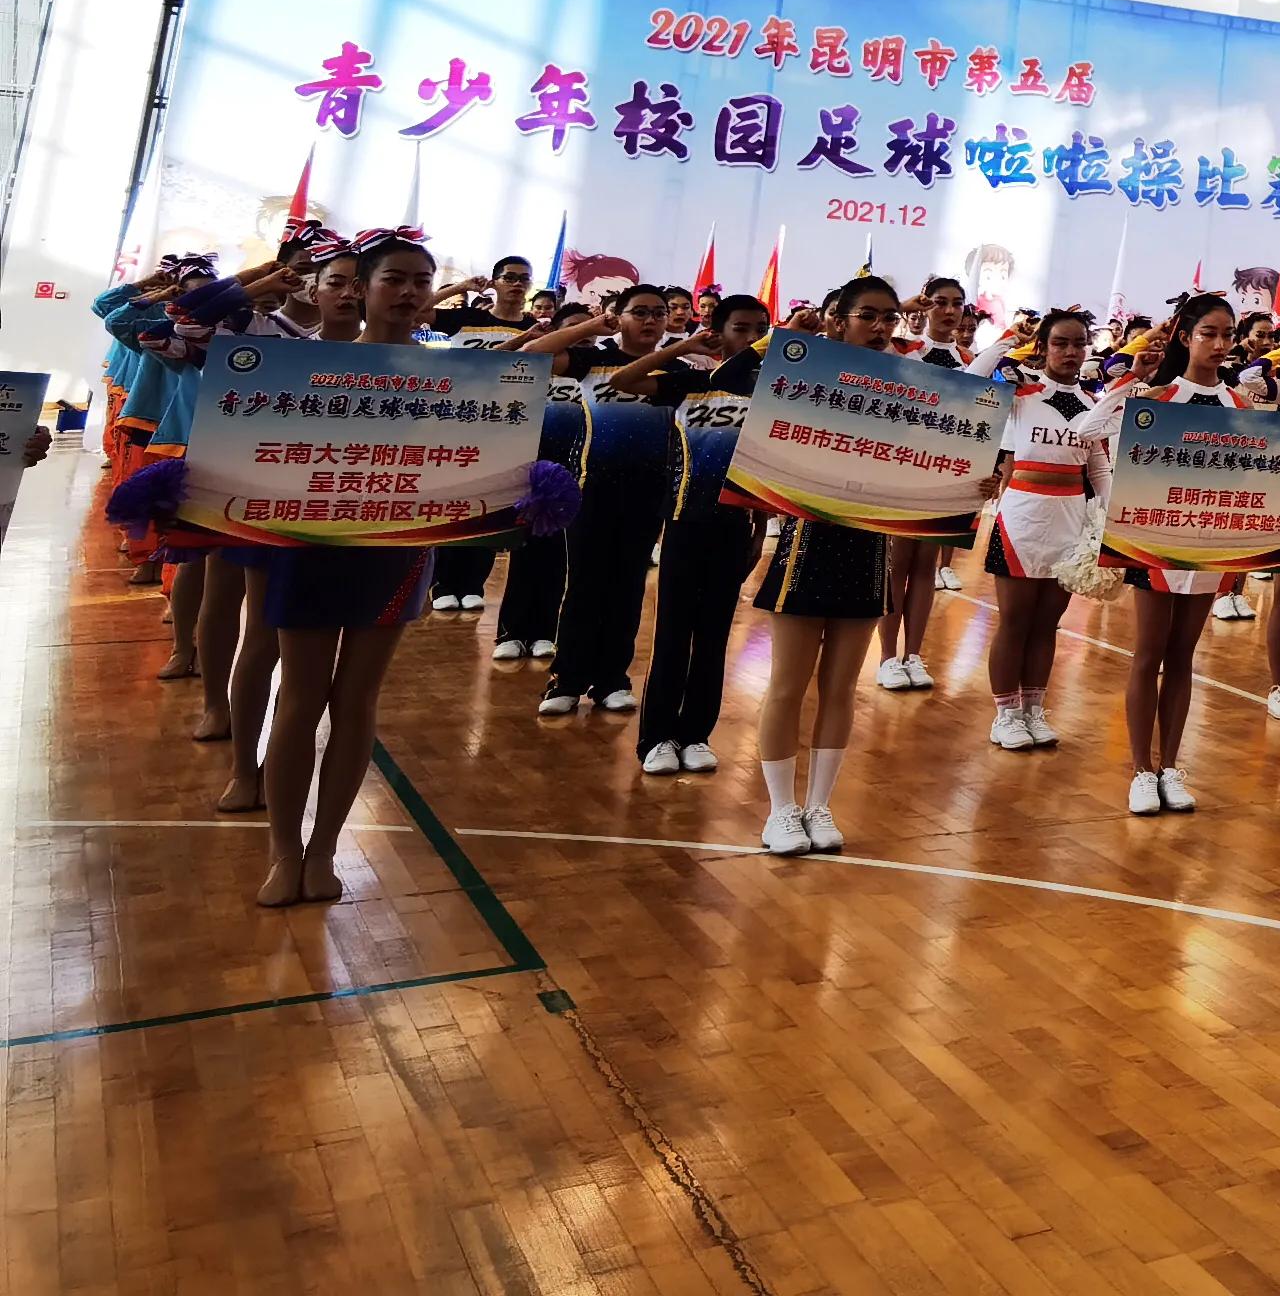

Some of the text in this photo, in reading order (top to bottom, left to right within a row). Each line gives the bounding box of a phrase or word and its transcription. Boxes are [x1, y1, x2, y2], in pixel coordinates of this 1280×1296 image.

[646, 8, 1096, 106] 2021年昆明市第五届
[826, 198, 928, 228] 2021.12
[309, 372, 452, 393] 2021年昆明市第五届
[838, 371, 940, 406] 2021年昆明市第五届
[217, 390, 529, 425] 青少年校园足球啦啦操比赛
[770, 376, 993, 443] 青少年校园足球啦啦操比赛
[254, 441, 481, 468] 云南大学附属中学
[768, 419, 972, 477] 昆明市五华区华山中学
[307, 471, 422, 494] 呈贡校区
[223, 497, 489, 523] （昆明呈贡新区中学）
[1167, 487, 1266, 509] 昆明市官渡区
